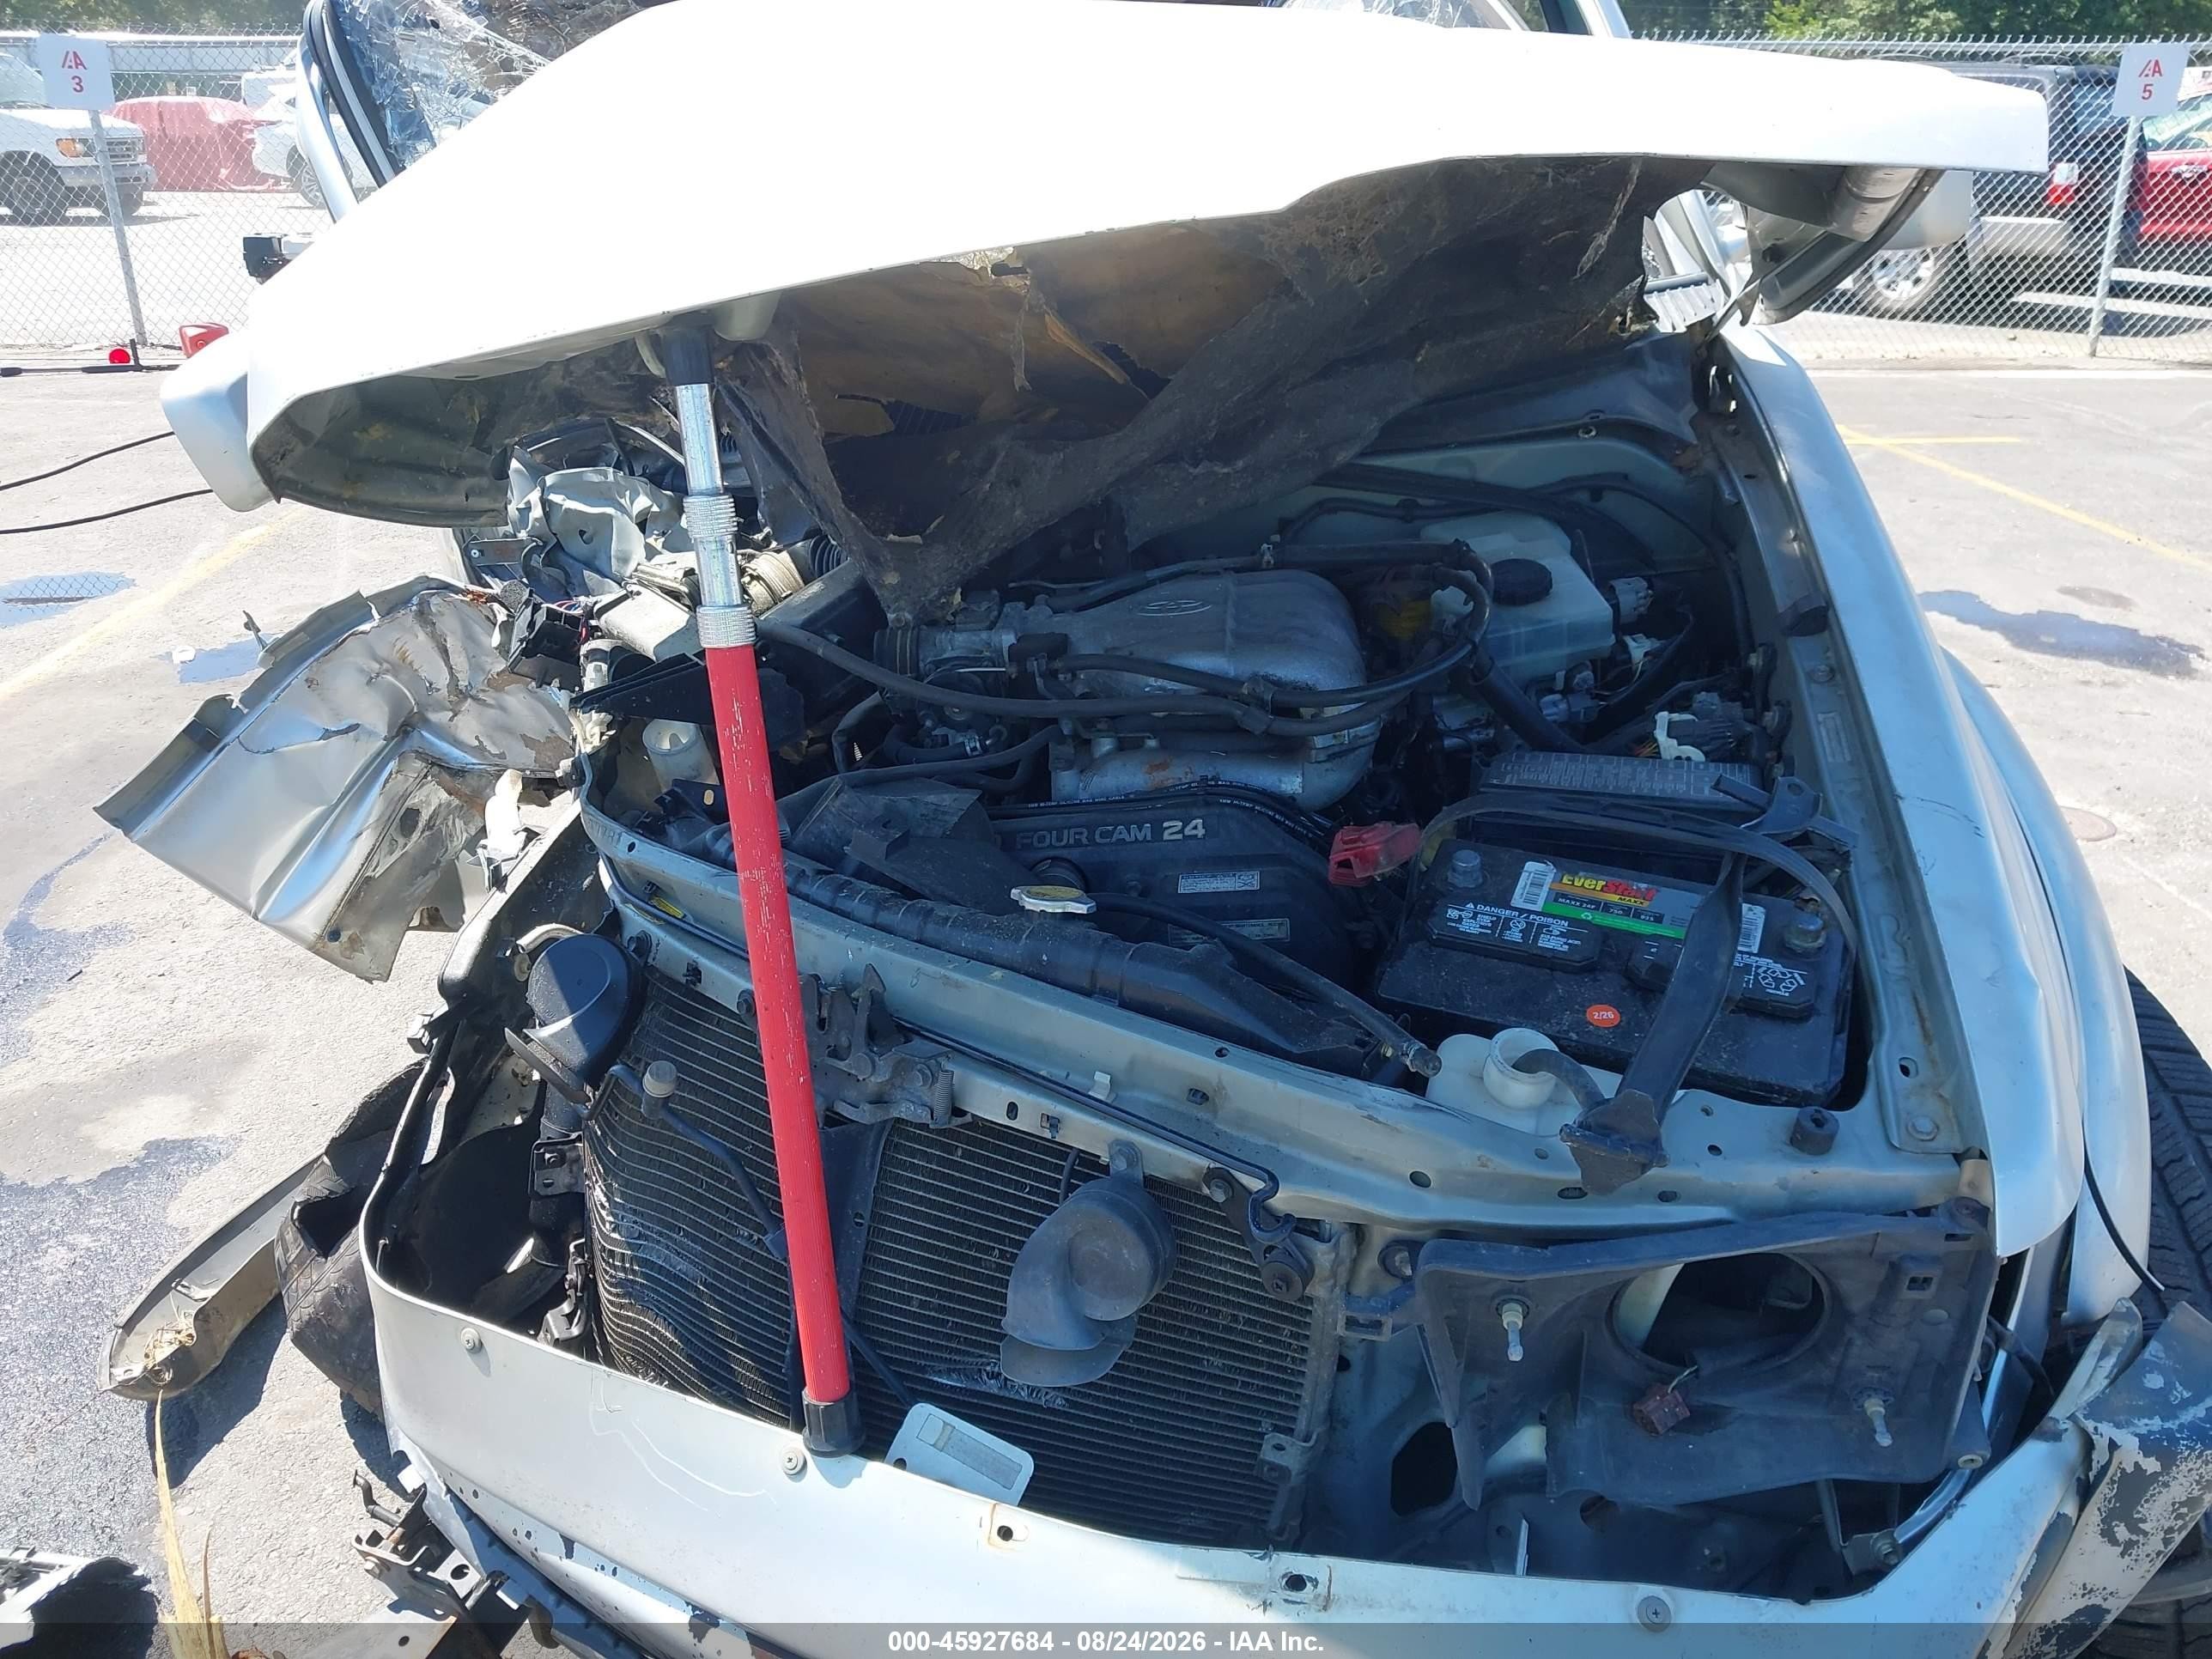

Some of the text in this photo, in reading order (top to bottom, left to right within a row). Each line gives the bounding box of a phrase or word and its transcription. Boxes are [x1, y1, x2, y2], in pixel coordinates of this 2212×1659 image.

[71, 75, 84, 93] 3
[2141, 83, 2154, 100] 5
[1016, 818, 1206, 849] FOUR CAM 24
[1558, 897, 1581, 907] MAXX
[1617, 896, 1645, 906] MAXX
[1476, 904, 1519, 918] DANGER
[1529, 914, 1569, 927] POISON
